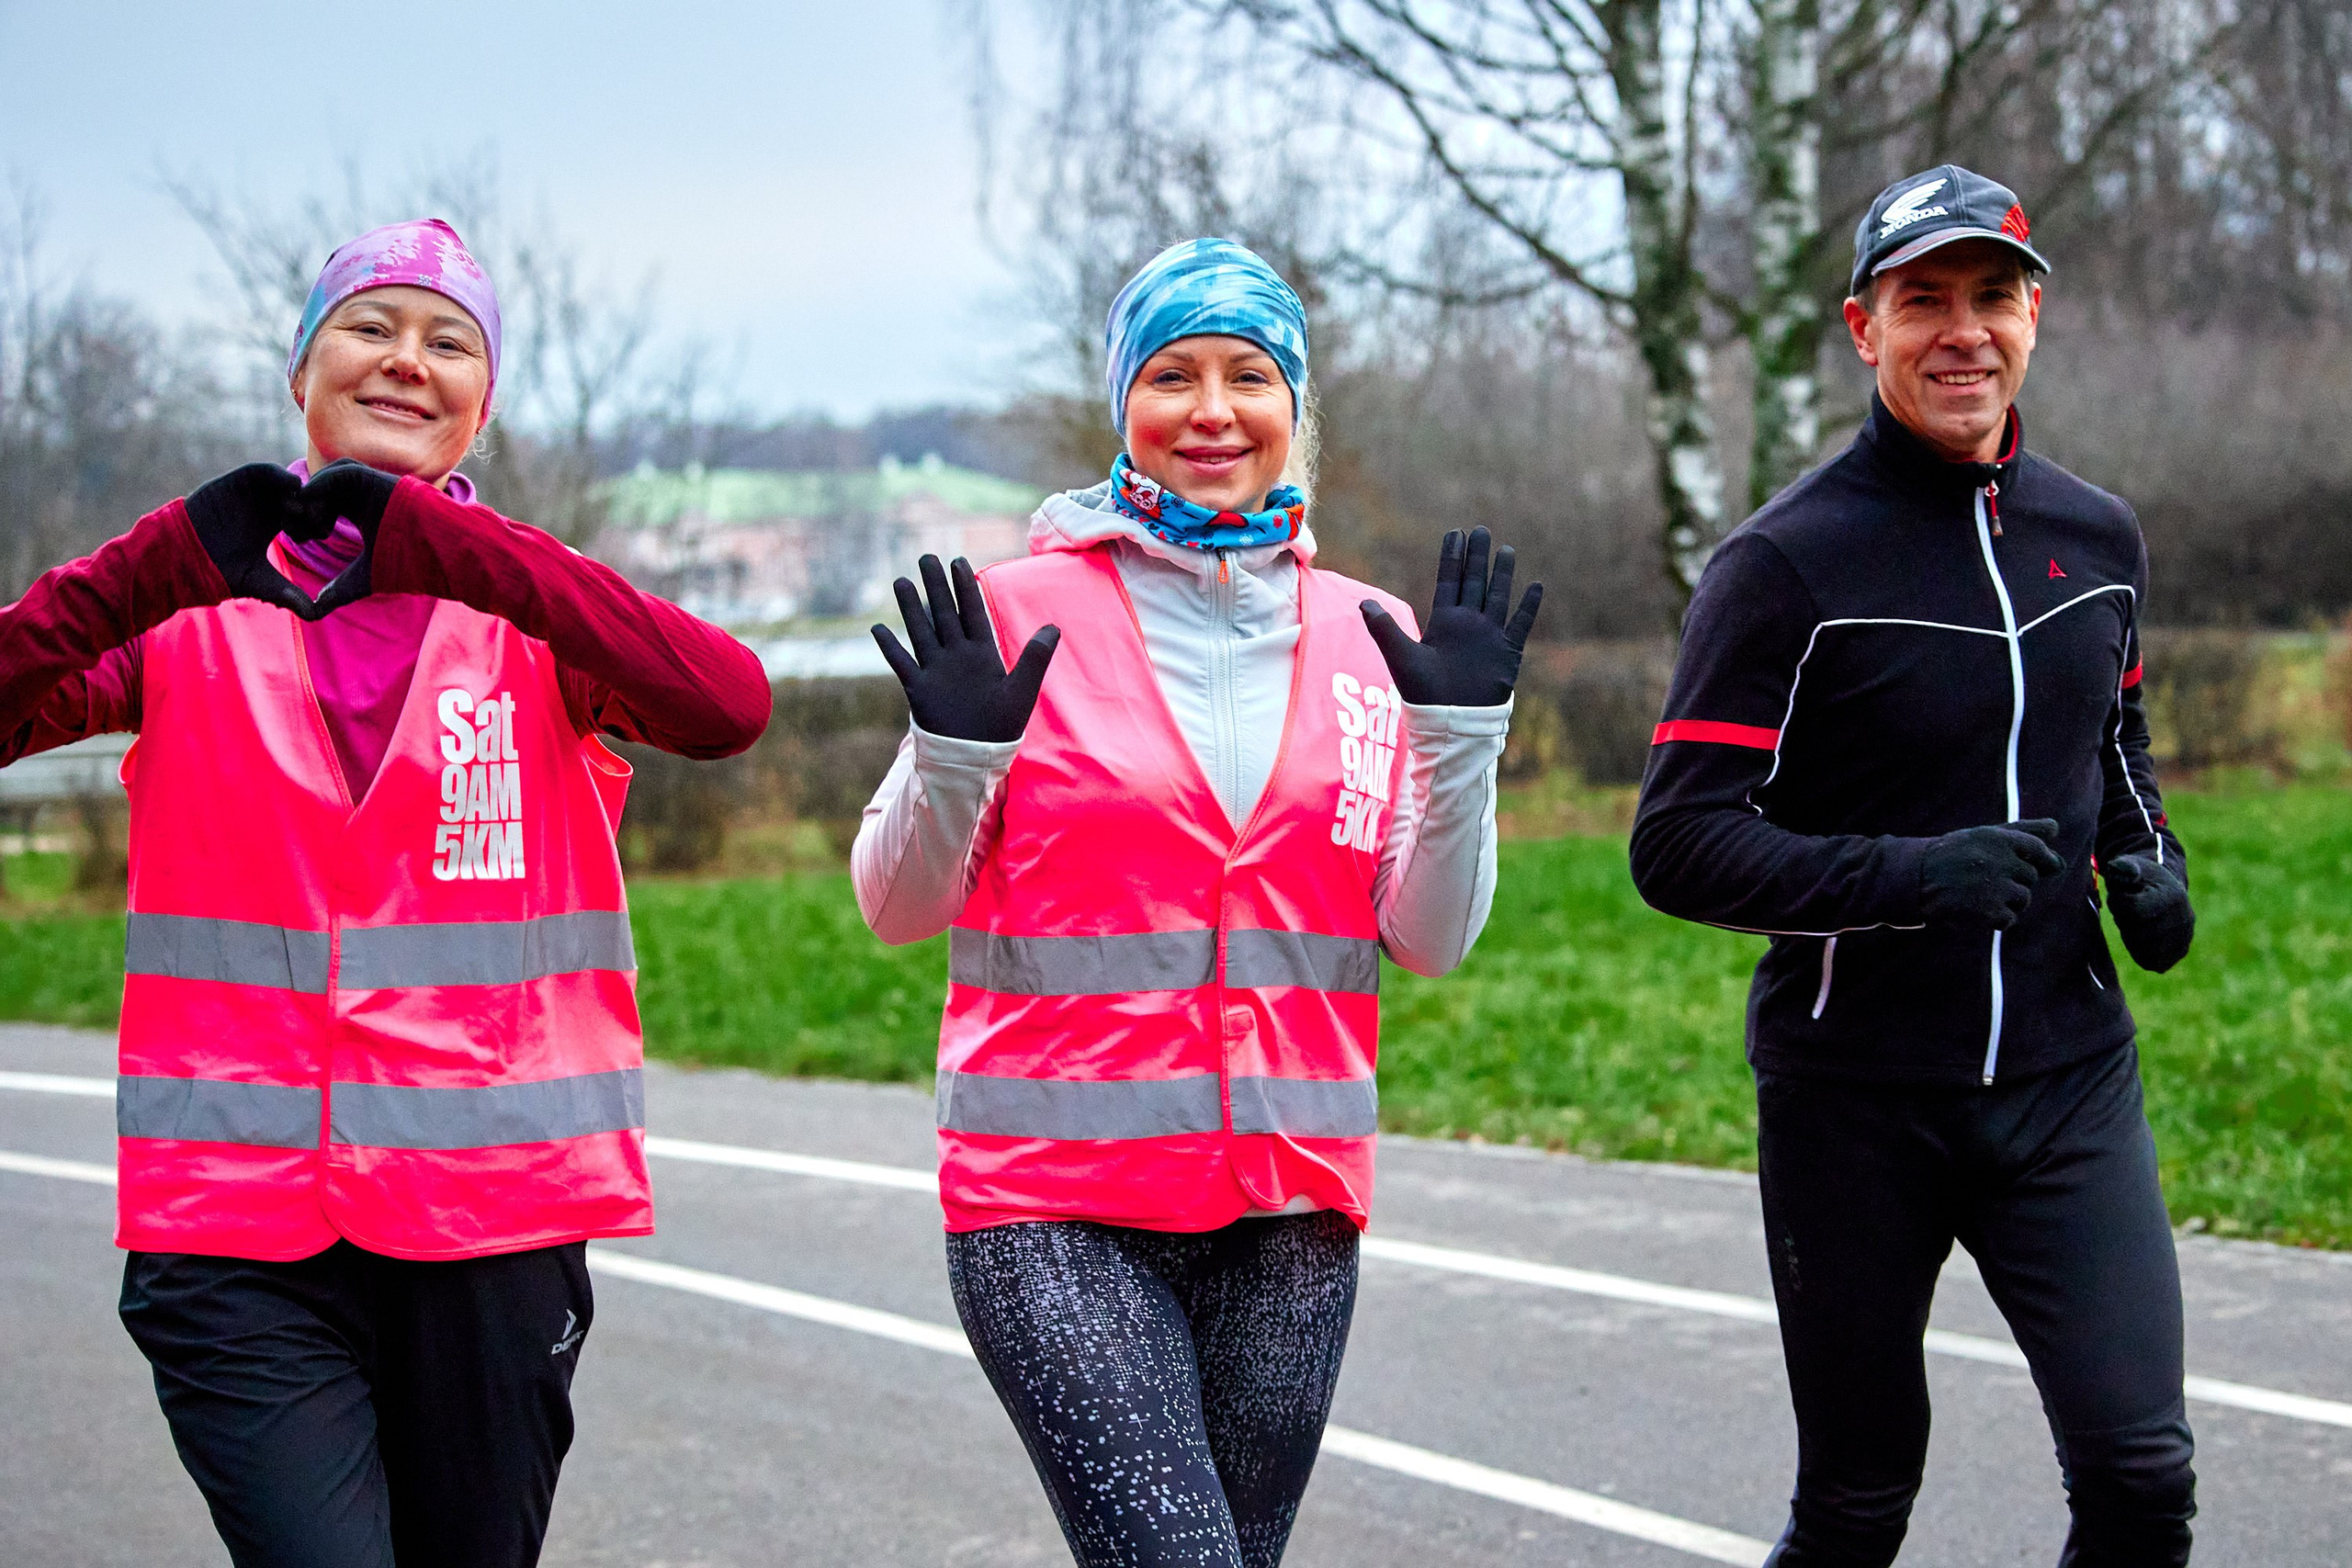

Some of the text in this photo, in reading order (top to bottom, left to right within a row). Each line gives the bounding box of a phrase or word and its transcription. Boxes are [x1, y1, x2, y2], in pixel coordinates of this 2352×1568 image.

[1880, 207, 1949, 240] HONDA
[437, 688, 519, 764] Sat
[1332, 672, 1402, 749] Sat
[439, 762, 522, 823] 9AM
[433, 821, 526, 881] 5KM
